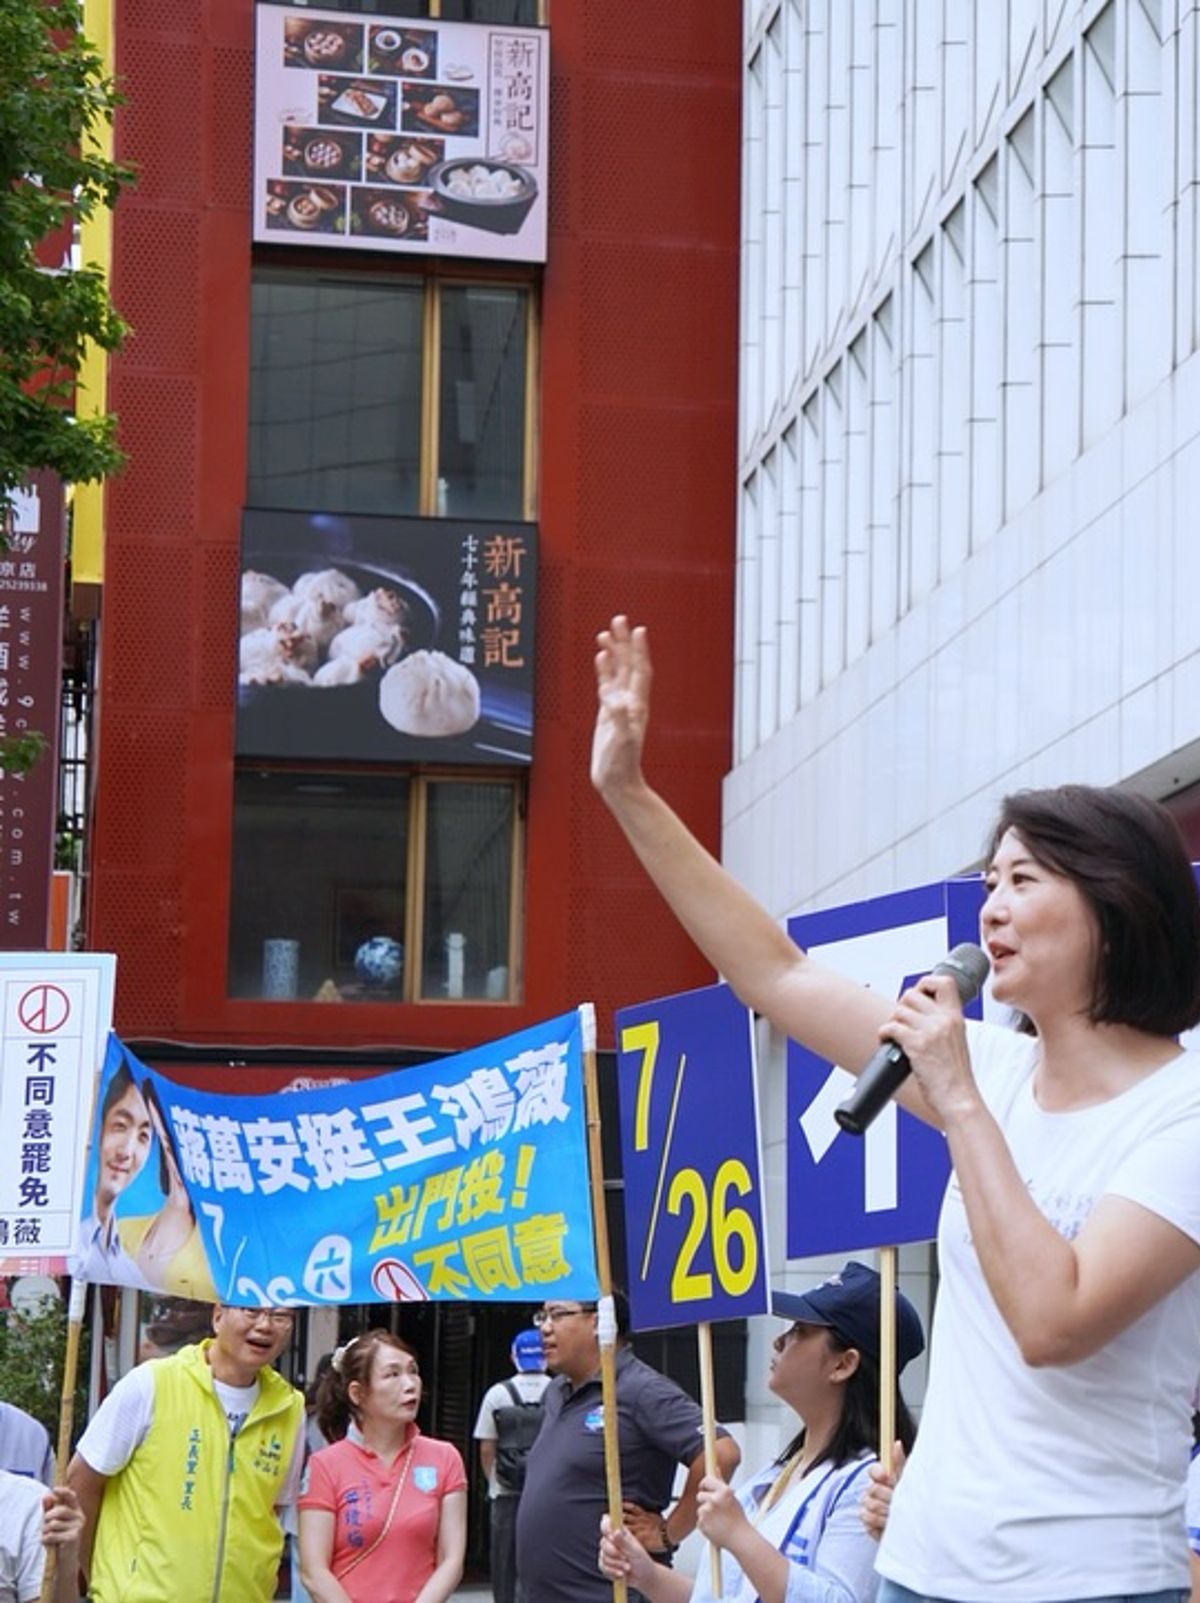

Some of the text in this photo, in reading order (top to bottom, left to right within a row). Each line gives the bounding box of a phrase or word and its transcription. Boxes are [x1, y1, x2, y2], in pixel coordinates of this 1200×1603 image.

[503, 39, 535, 131] 新高記
[480, 534, 526, 668] 新高記
[19, 1042, 57, 1208] 不同意罷免
[170, 1041, 571, 1195] 蔣萬安挺王鴻薇
[413, 1213, 571, 1297] 不同意
